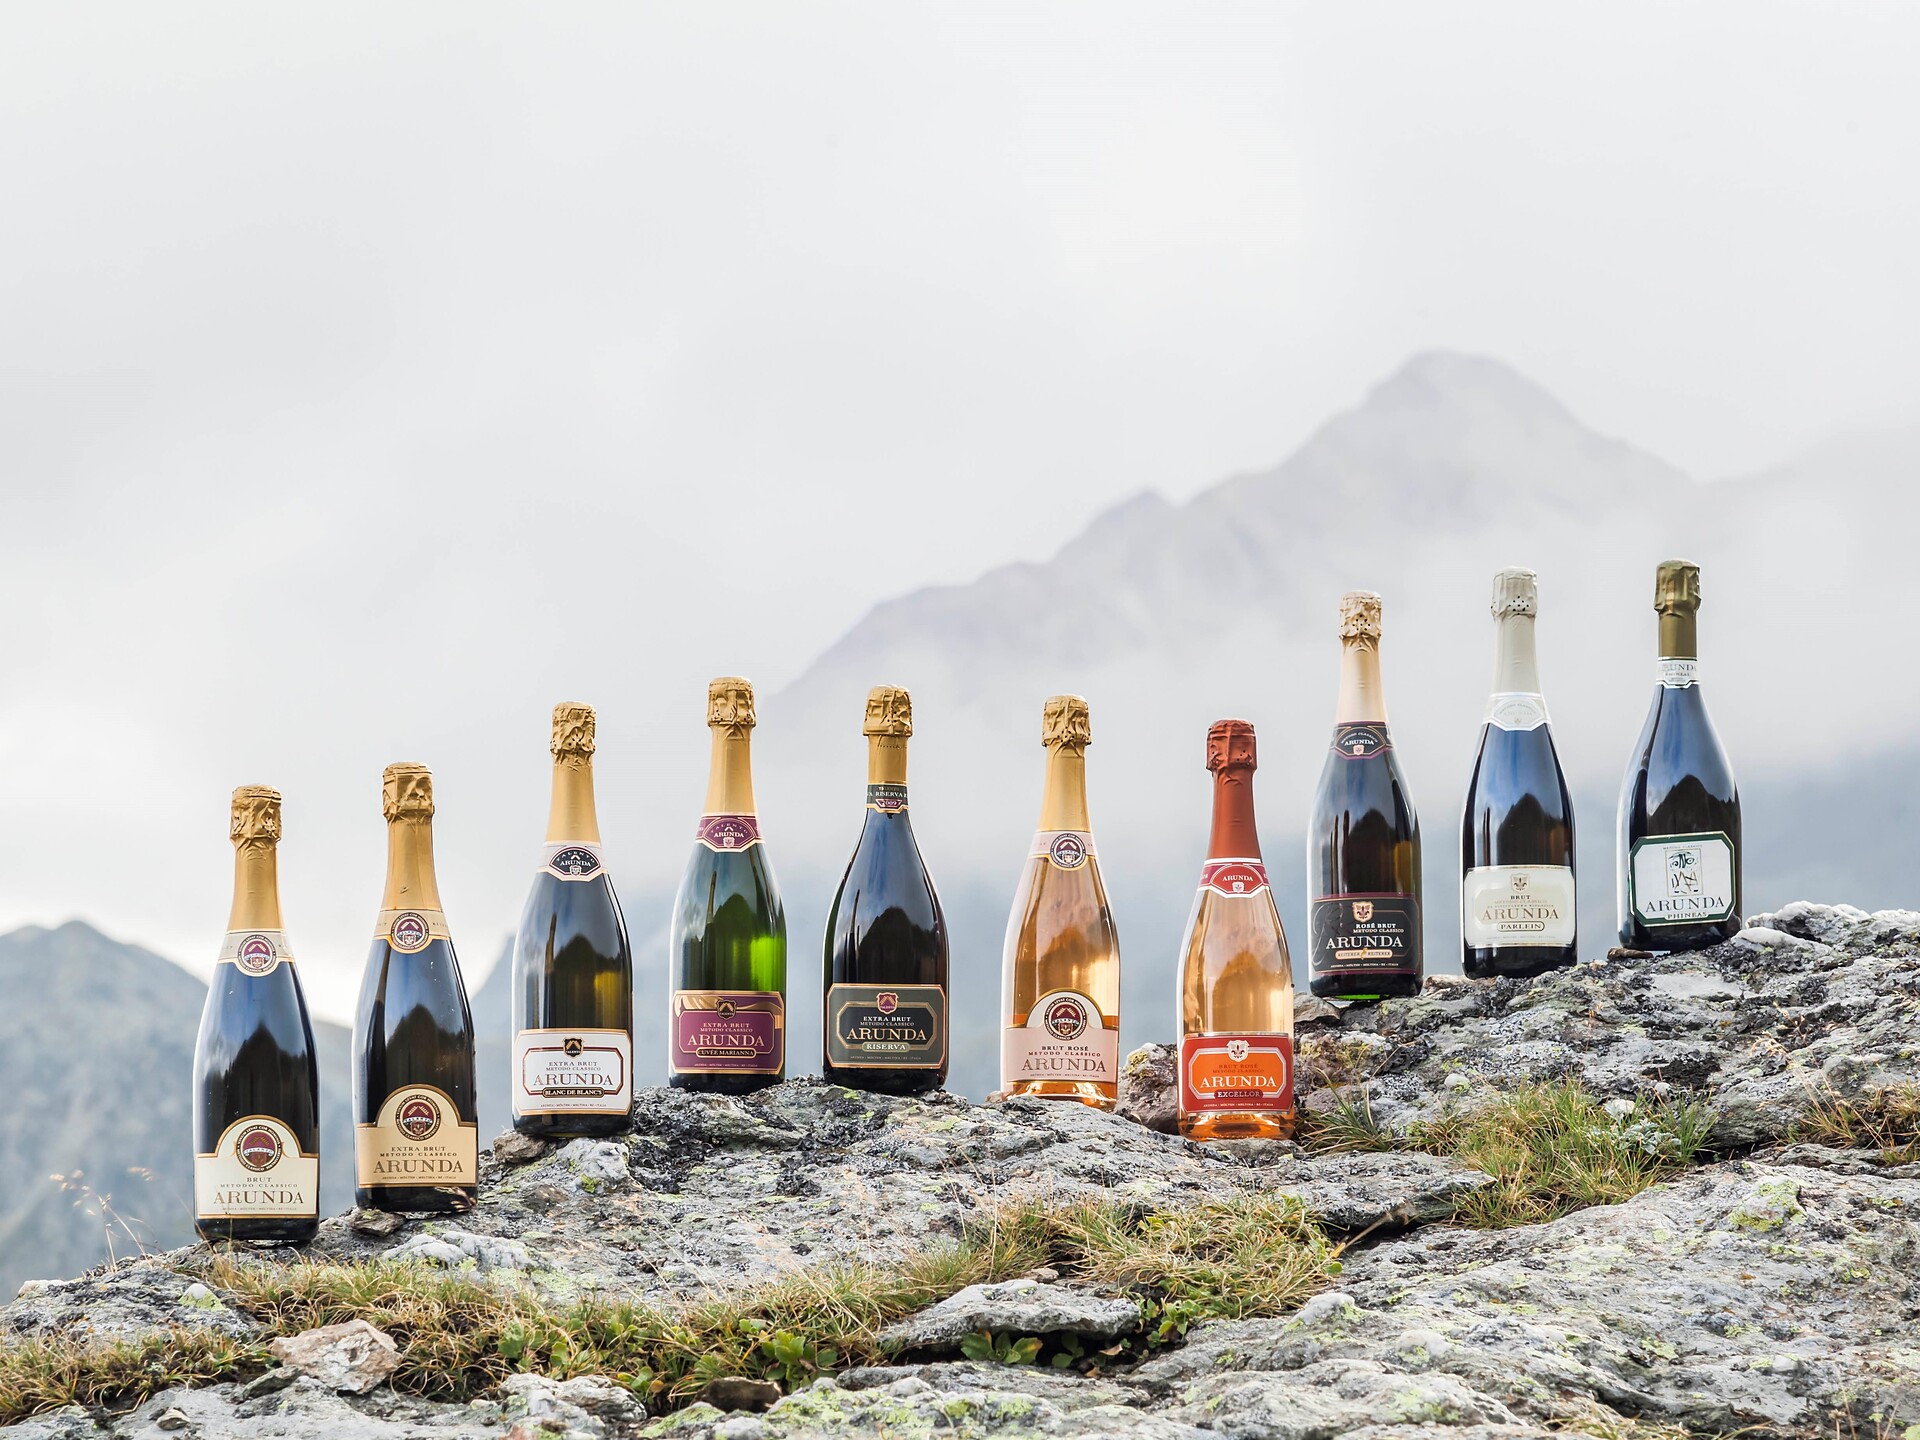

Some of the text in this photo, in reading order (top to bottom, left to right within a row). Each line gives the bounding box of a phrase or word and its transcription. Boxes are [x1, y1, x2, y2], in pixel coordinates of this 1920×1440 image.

[1646, 896, 1725, 912] ARUNDA
[1482, 908, 1559, 920] ARUNDA
[1326, 936, 1403, 950] ARUNDA
[688, 1034, 765, 1046] ARUNDA
[846, 1028, 927, 1041] ARUNDA
[698, 1048, 719, 1056] CUVÉE
[1022, 1058, 1106, 1072] ARUNDA
[534, 1073, 614, 1086] ARUNDA
[1200, 1075, 1277, 1088] ARUNDA
[373, 1159, 464, 1174] ARUNDA
[214, 1190, 304, 1204] ARUNDA
